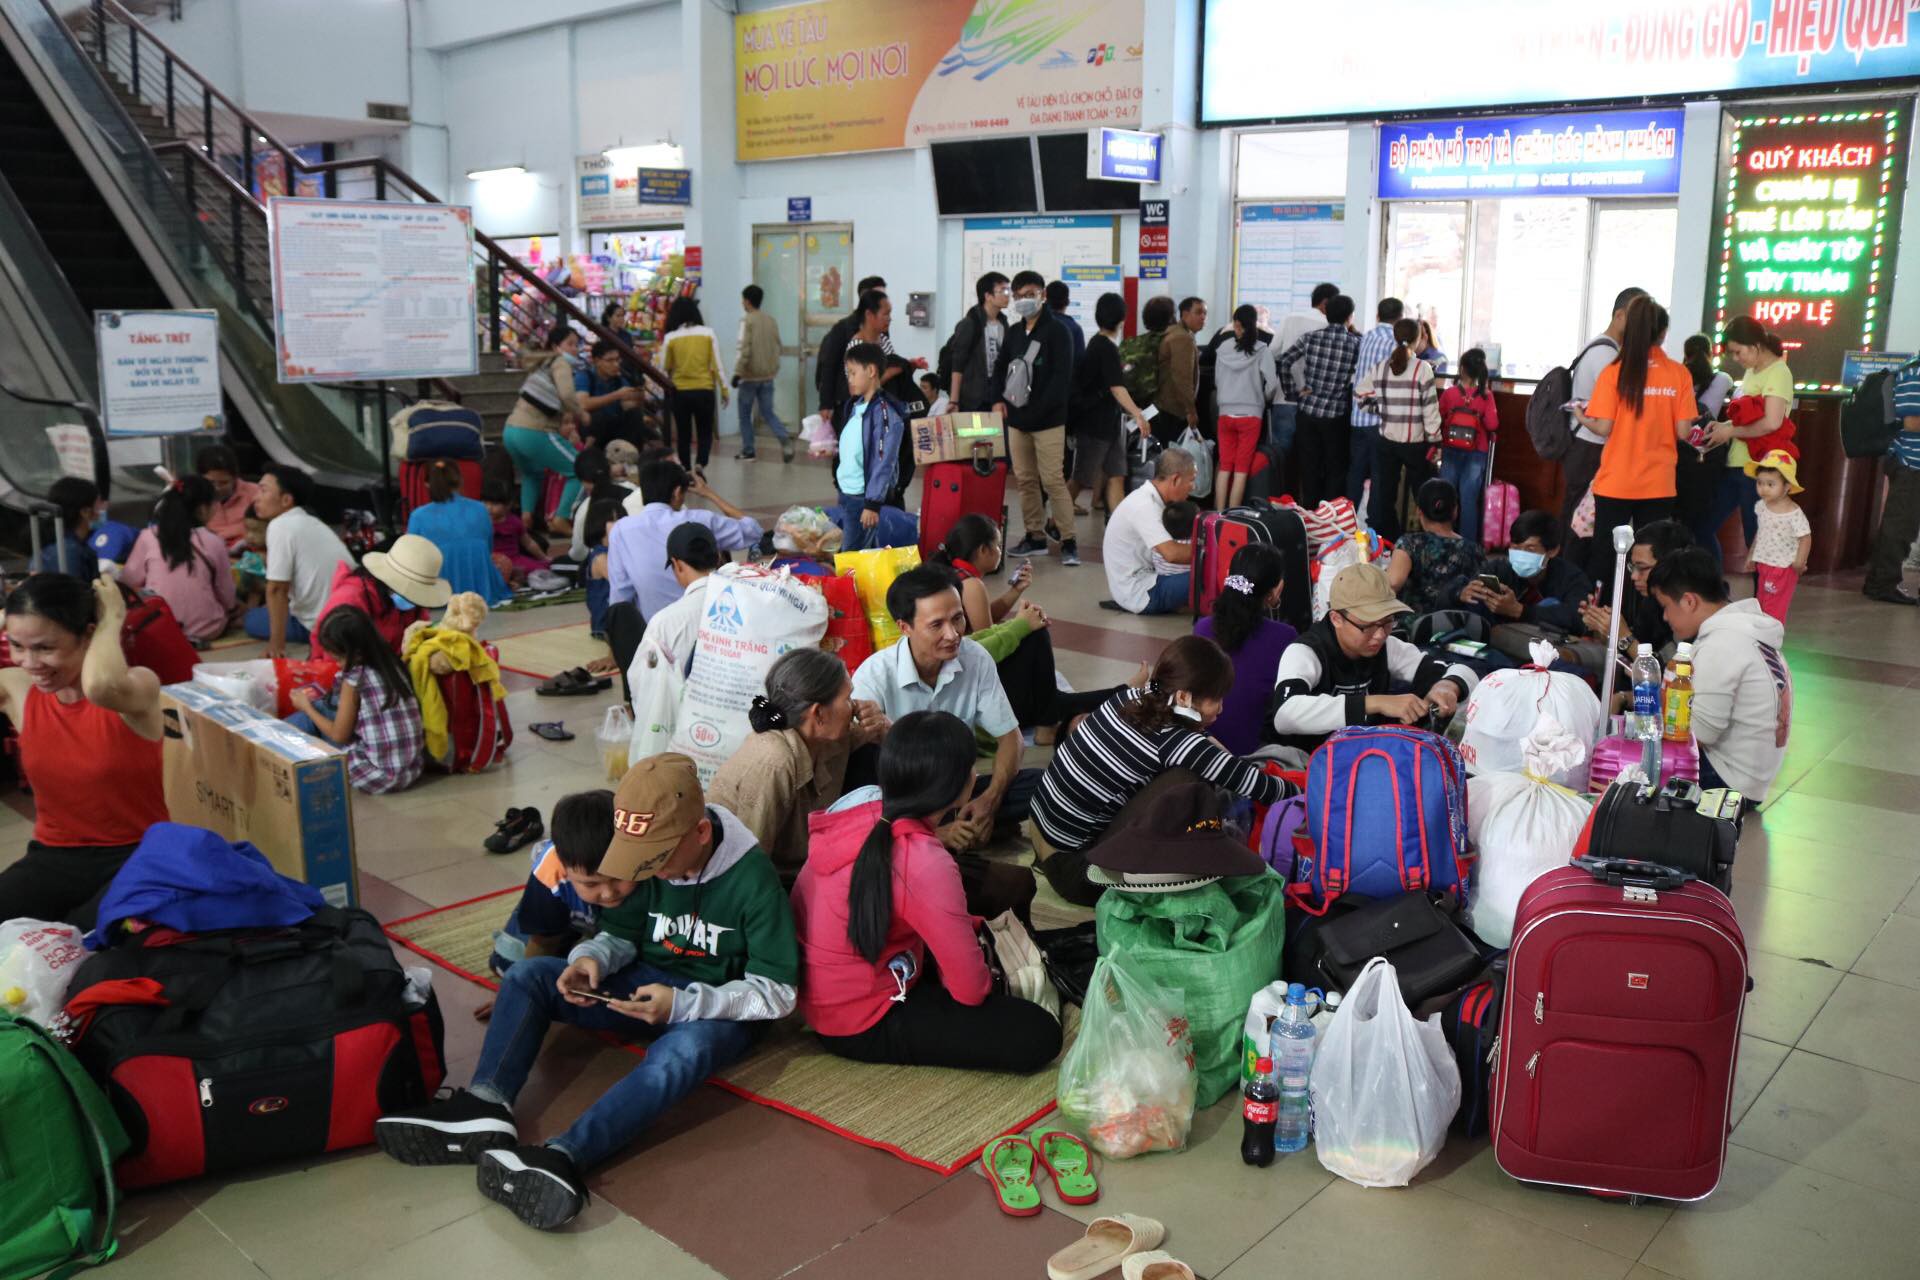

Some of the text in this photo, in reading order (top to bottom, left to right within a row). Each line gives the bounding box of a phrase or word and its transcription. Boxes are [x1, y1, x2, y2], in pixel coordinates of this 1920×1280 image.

[744, 63, 779, 99] MỌI
[827, 51, 864, 89] MỌI
[1750, 143, 1873, 170] QUÝ KHÁCH
[1146, 203, 1164, 216] WC
[1755, 301, 1834, 327] HỢP LỆ
